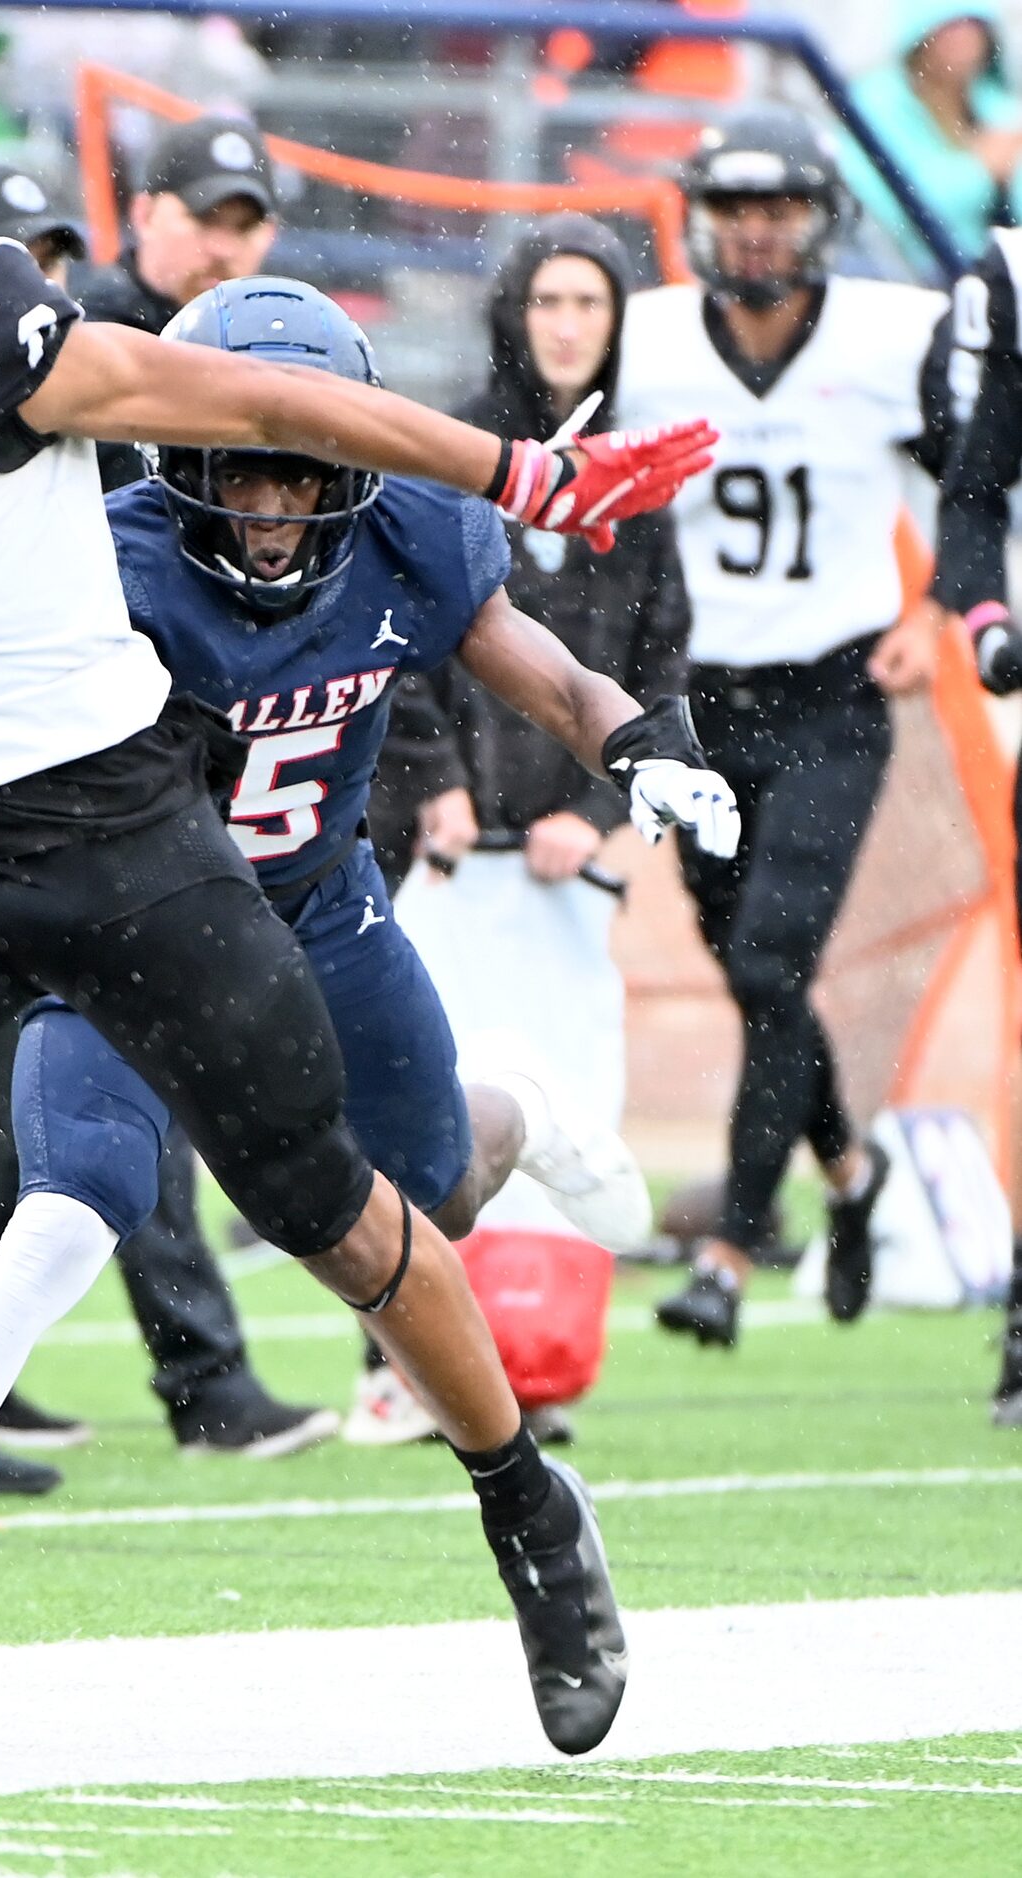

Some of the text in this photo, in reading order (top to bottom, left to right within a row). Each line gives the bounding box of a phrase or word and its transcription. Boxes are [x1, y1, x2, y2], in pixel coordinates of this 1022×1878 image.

[714, 465, 812, 581] 91
[228, 667, 395, 732] ALLEN
[227, 722, 350, 863] 5
